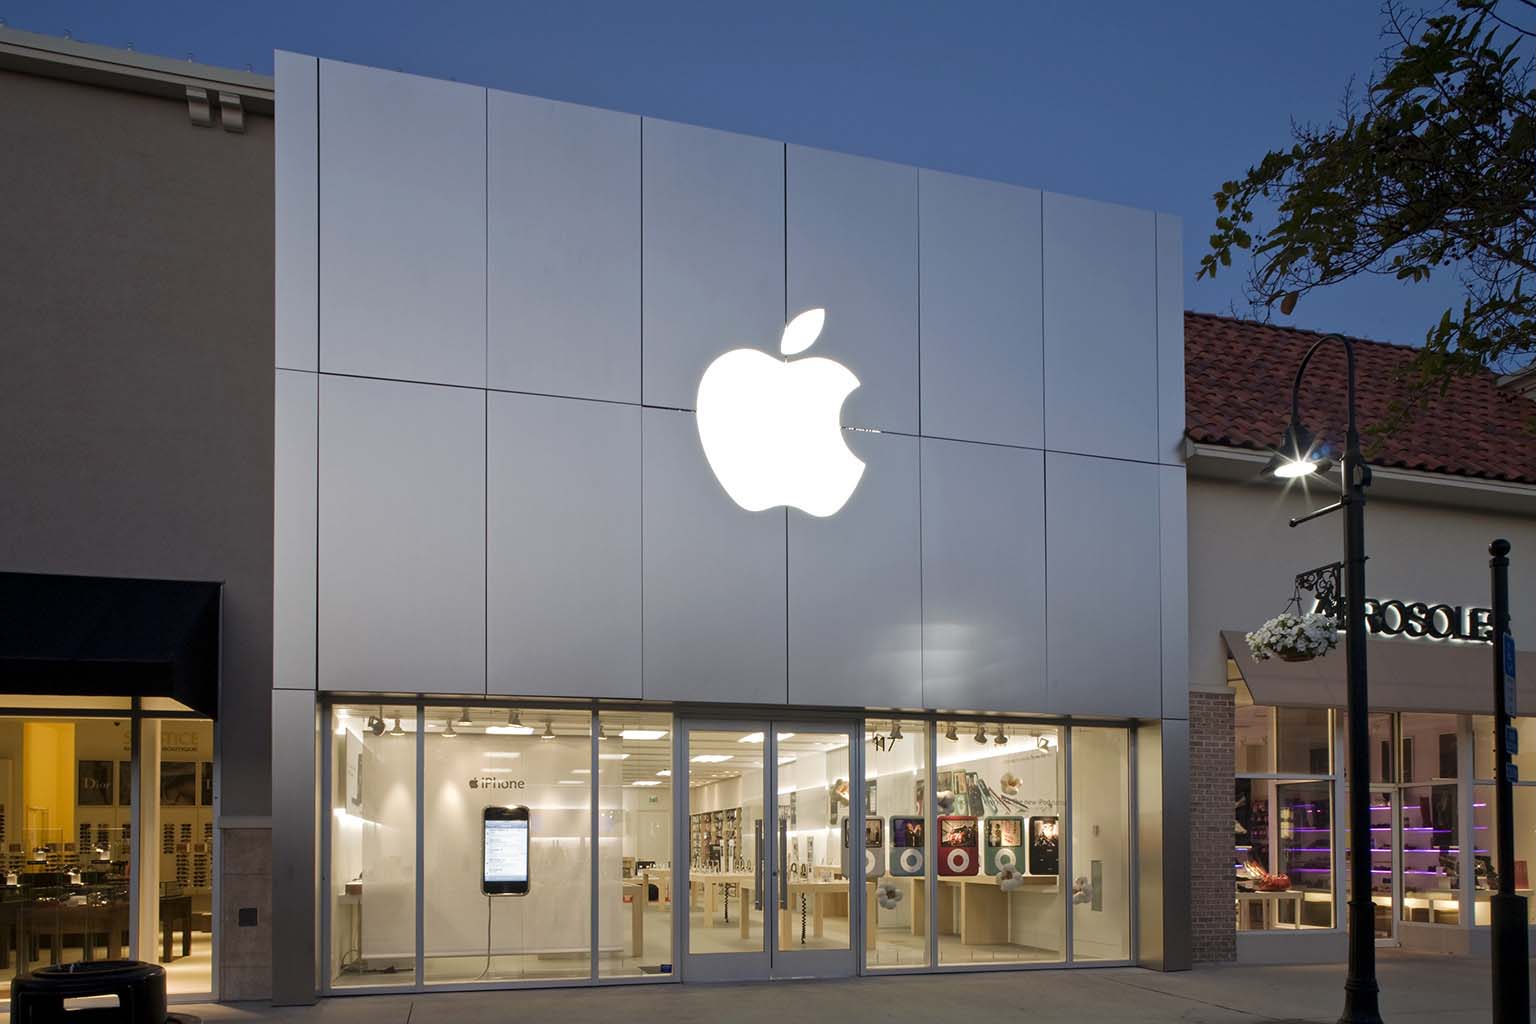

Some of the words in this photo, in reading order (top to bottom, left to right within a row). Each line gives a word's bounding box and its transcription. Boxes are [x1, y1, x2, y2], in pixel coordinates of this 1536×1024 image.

[1312, 593, 1495, 640] AEROSOLE
[874, 736, 896, 752] 117
[84, 777, 110, 790] Dior
[481, 777, 525, 789] iPhone
